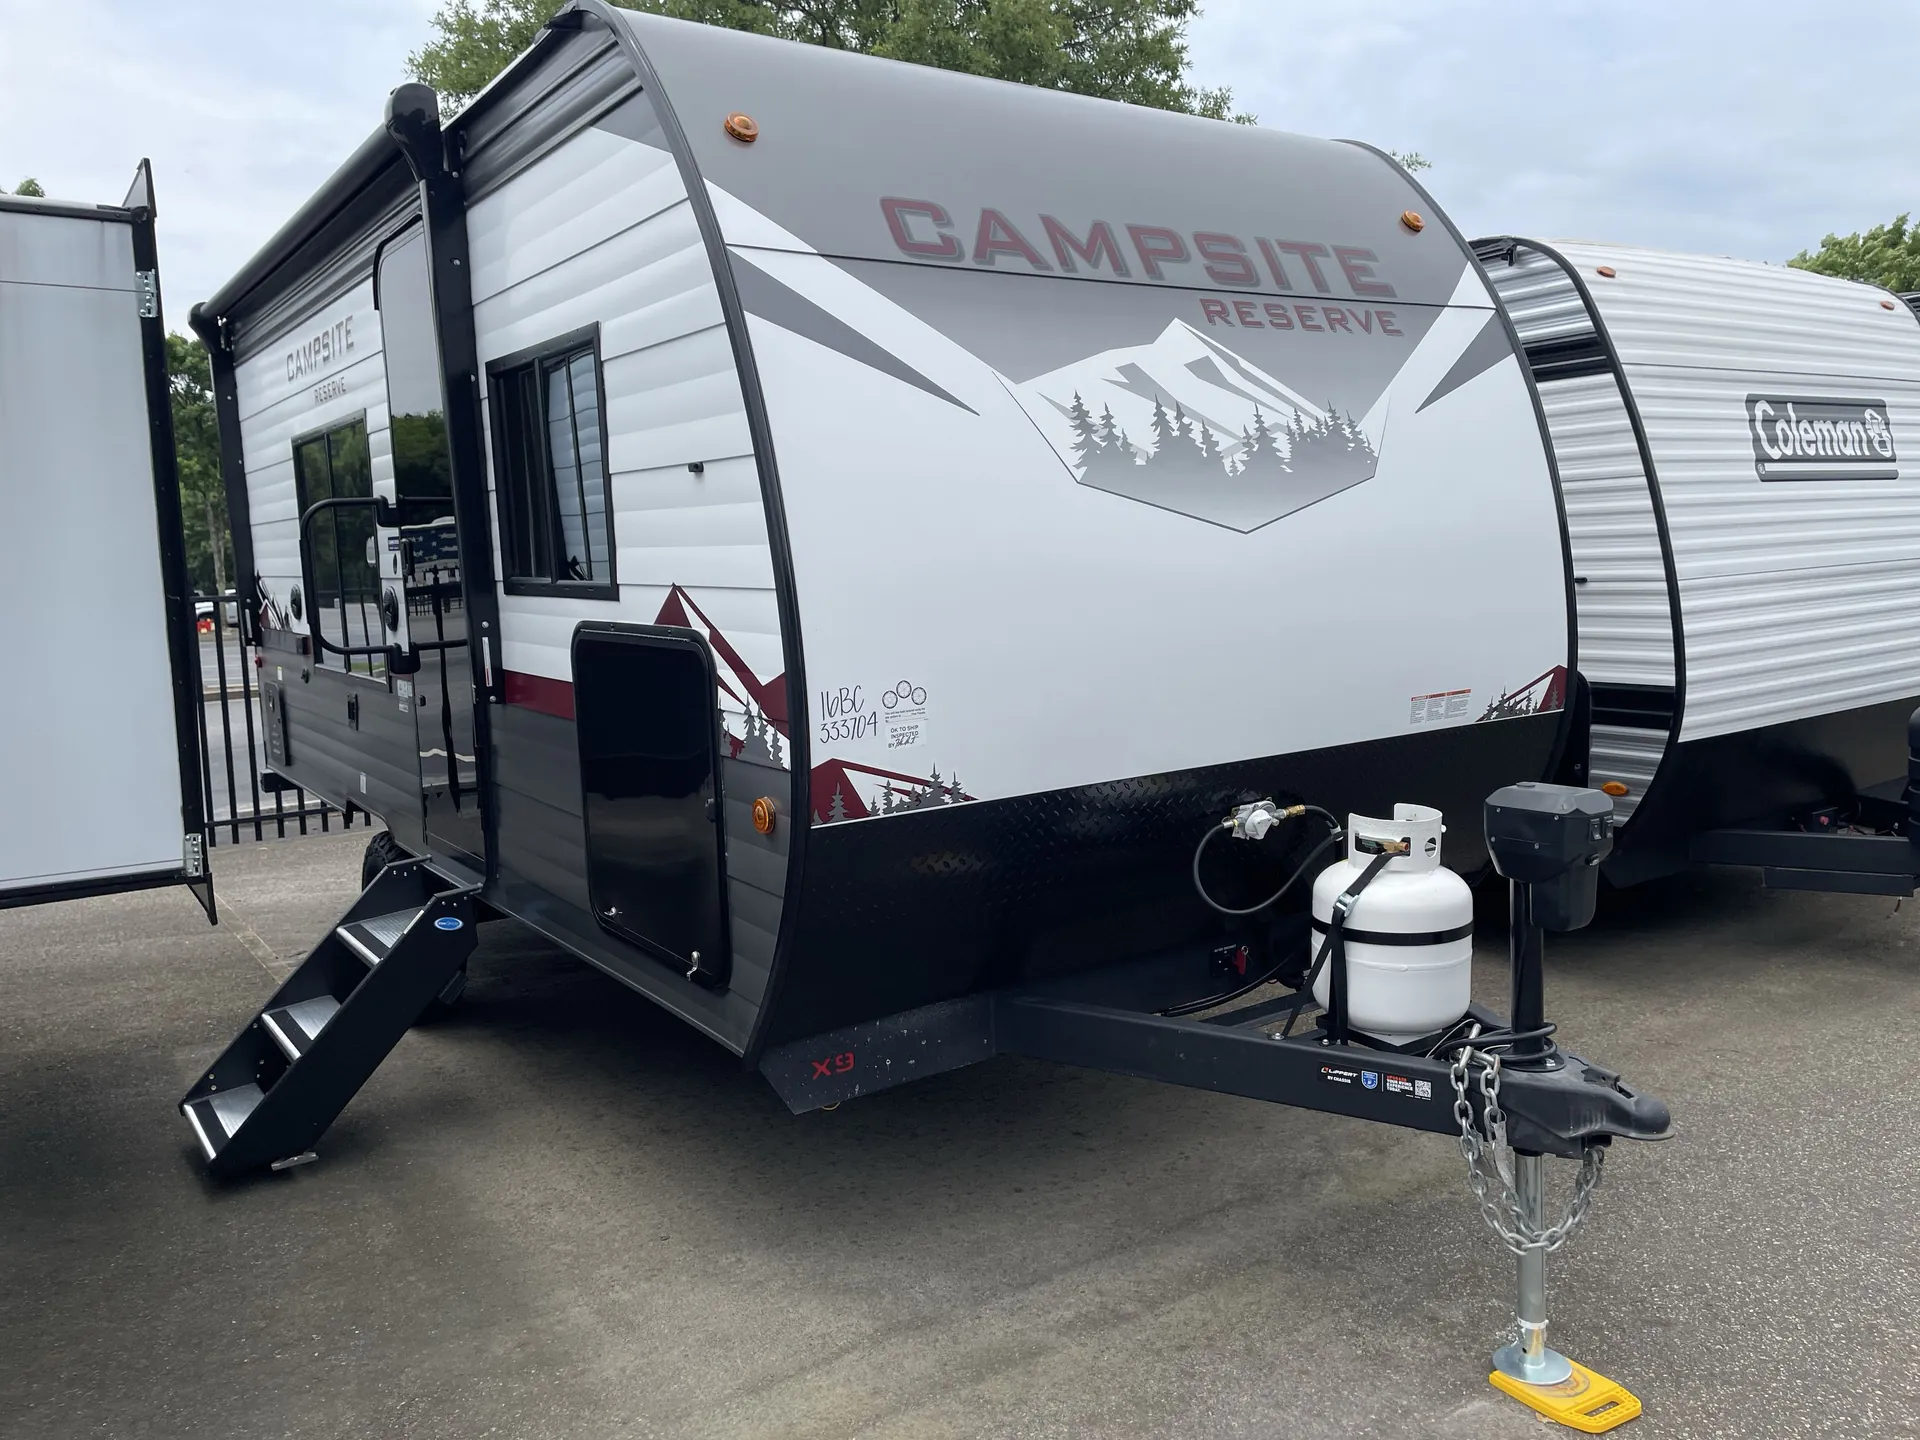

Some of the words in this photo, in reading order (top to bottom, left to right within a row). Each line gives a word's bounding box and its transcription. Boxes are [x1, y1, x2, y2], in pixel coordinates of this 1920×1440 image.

[879, 195, 1398, 298] CAMPSITE
[1199, 298, 1405, 337] RESERVE
[286, 314, 354, 382] CAMPSITE
[313, 376, 347, 404] RESERVE
[1754, 399, 1870, 460] Coleman
[820, 684, 865, 721] 16BC
[819, 711, 879, 744] 333704
